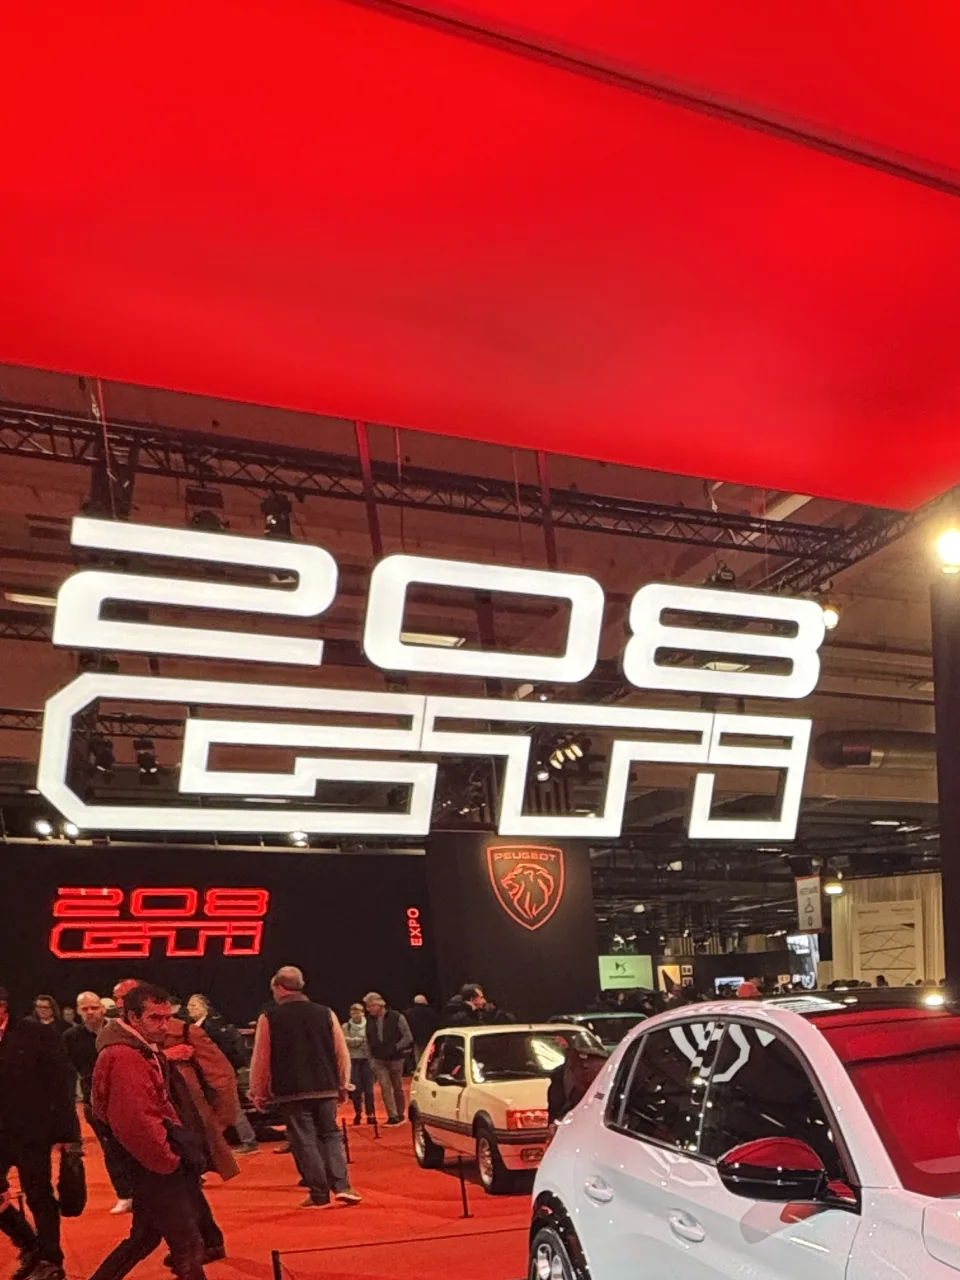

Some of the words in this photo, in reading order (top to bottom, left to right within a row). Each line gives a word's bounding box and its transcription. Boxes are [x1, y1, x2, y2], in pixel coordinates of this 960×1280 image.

[53, 516, 826, 699] 208
[494, 852, 556, 861] PEUGEOT
[52, 887, 269, 917] 208
[406, 907, 423, 946] EXPO
